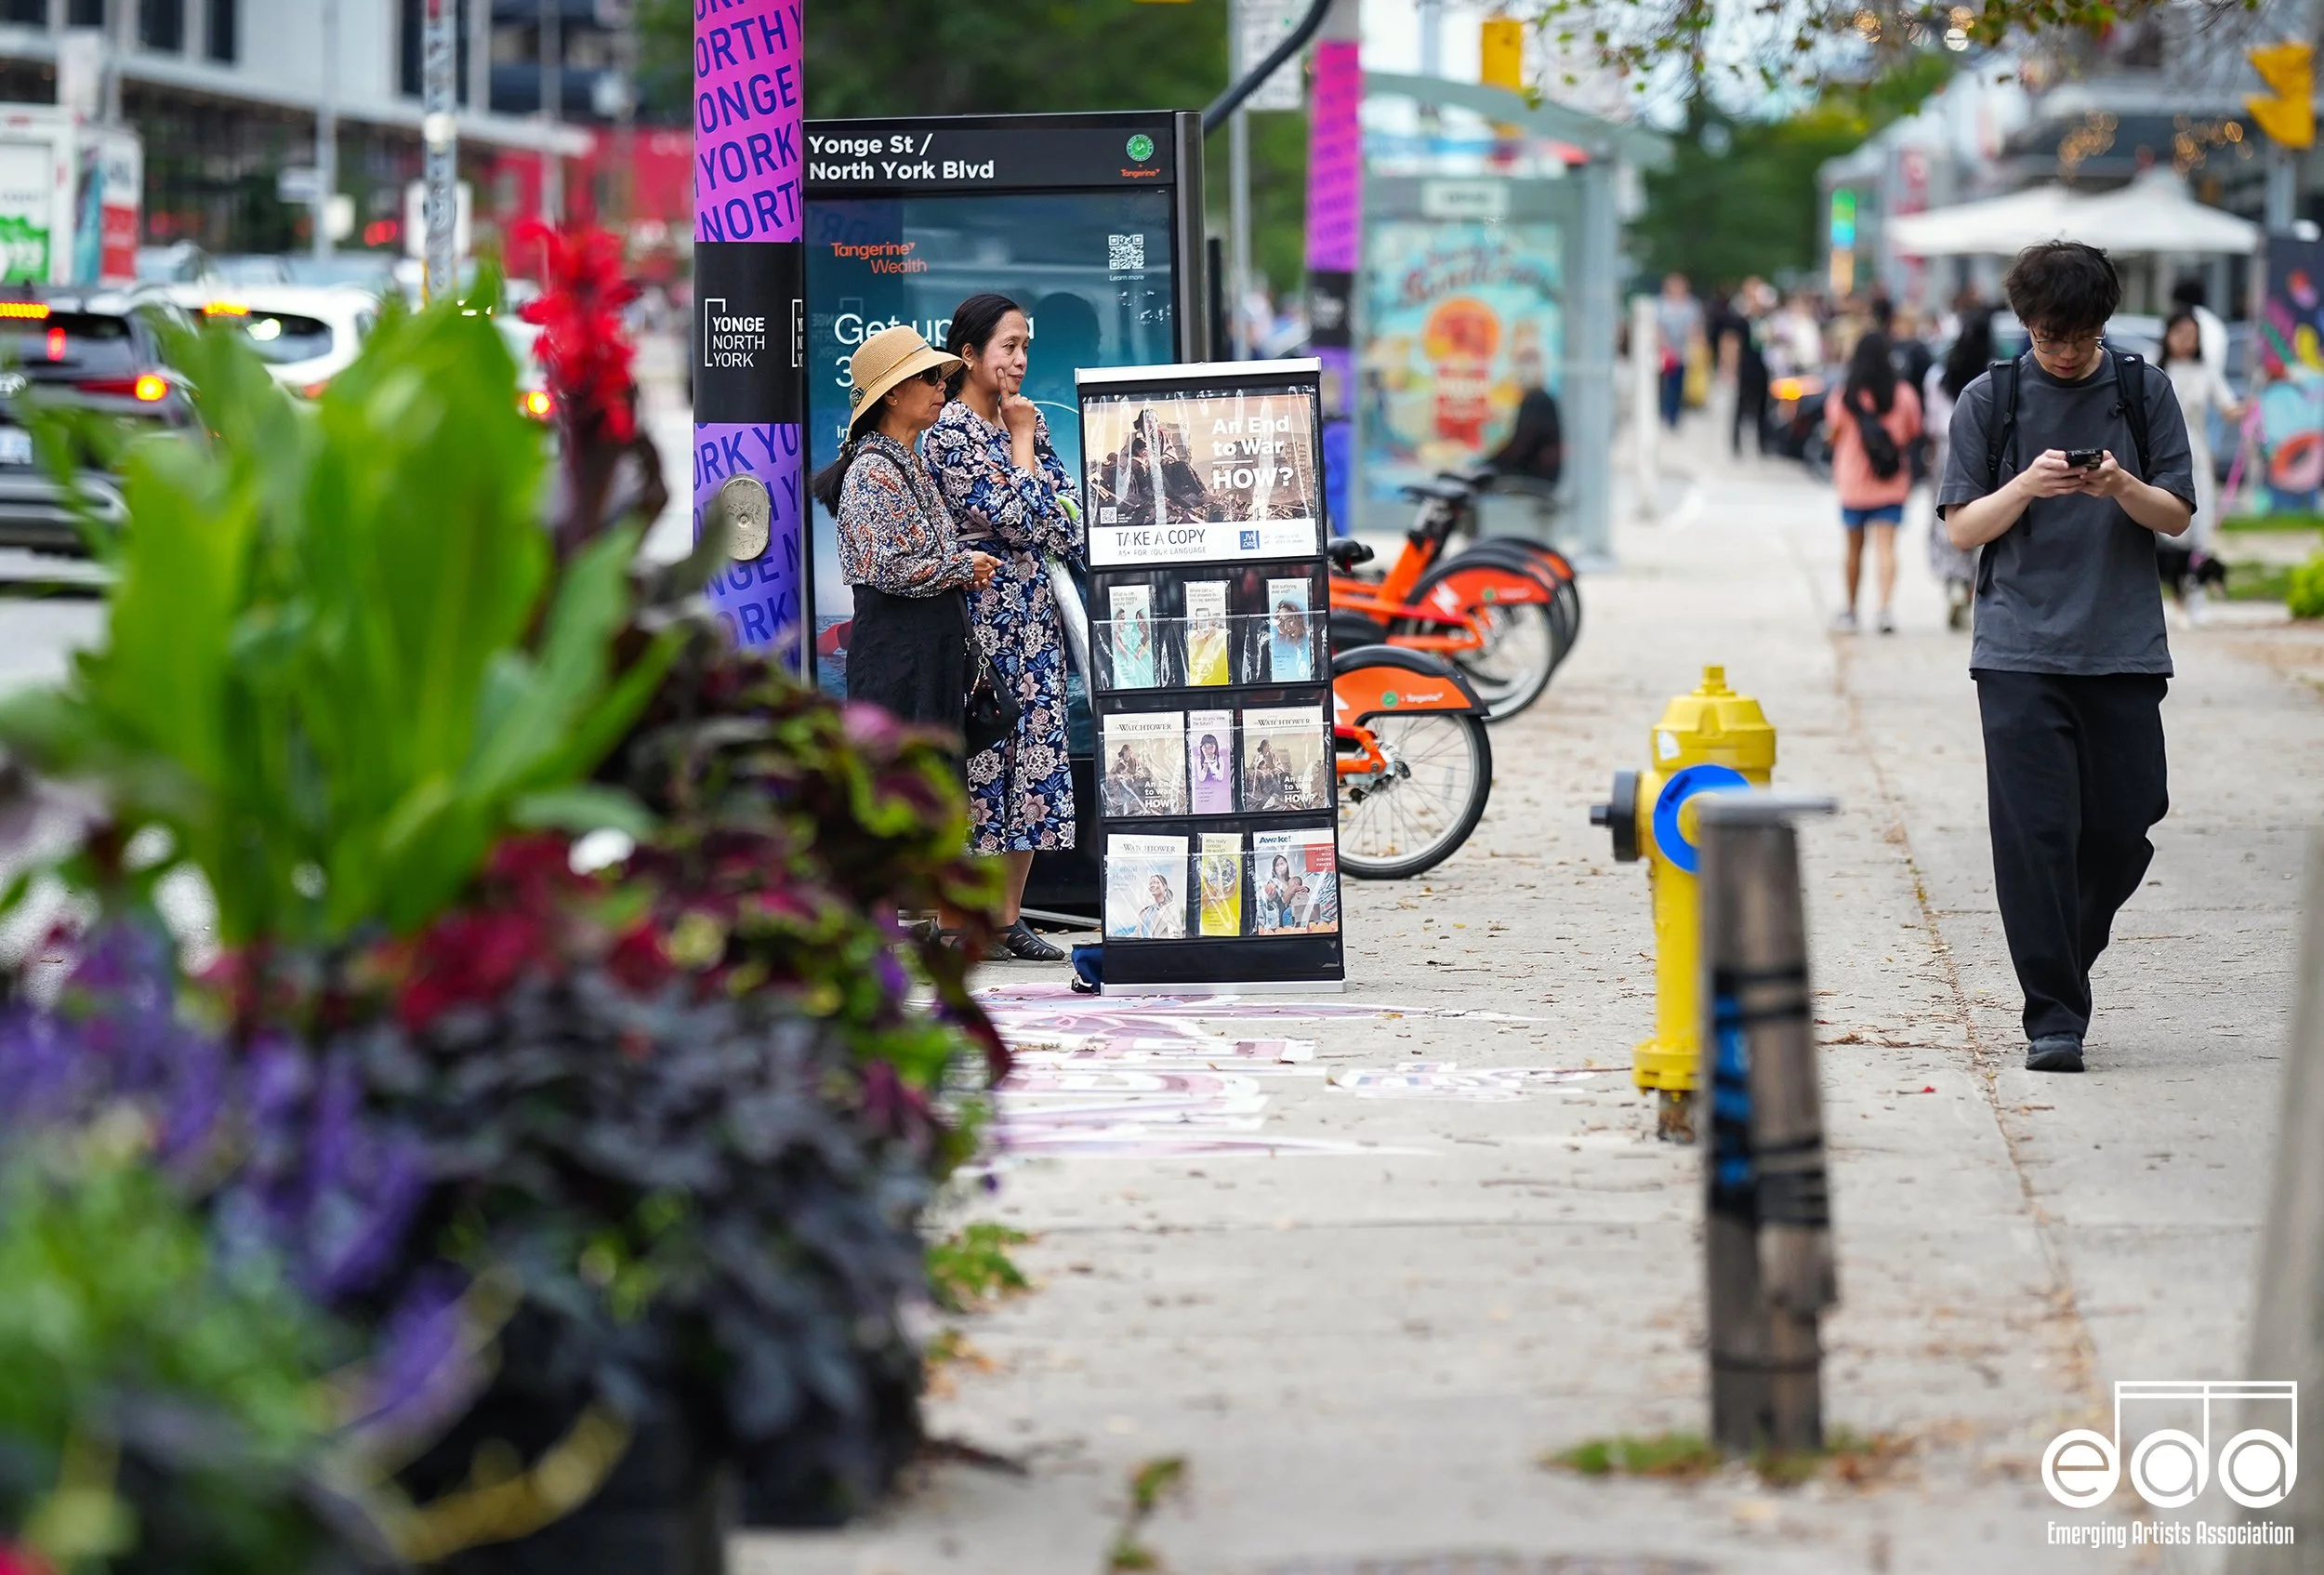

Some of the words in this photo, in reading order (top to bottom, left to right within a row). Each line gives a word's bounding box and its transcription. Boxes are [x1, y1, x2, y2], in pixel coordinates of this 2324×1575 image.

[695, 64, 798, 139] ONGE
[808, 136, 883, 157] Yonge
[890, 135, 914, 153] St
[918, 133, 934, 156] /
[699, 122, 799, 191] YORK
[809, 161, 875, 180] North
[881, 161, 936, 179] York
[943, 160, 995, 179] Blvd
[1120, 168, 1159, 178] Tangerine
[831, 242, 914, 260] Tangerine
[870, 258, 928, 274] Wealth
[712, 316, 766, 332] YONGE
[712, 335, 766, 351] NORTH
[713, 352, 755, 368] YORK
[1211, 417, 1243, 435] An
[1248, 415, 1289, 434] End
[1211, 440, 1237, 457] to
[1240, 437, 1285, 456] War
[1212, 466, 1295, 490] HOW?
[1116, 531, 1150, 547] TAKE
[1154, 530, 1165, 545] A
[1168, 528, 1206, 545] COPY
[1243, 533, 1256, 541] JW
[1169, 546, 1207, 555] LANGUAGE
[1118, 723, 1172, 732] WATCHTOWER
[1258, 718, 1311, 726] WATCHTOWER
[1284, 783, 1294, 791] to
[1144, 799, 1177, 809] HOW?
[1123, 843, 1176, 853] WATHTOWER
